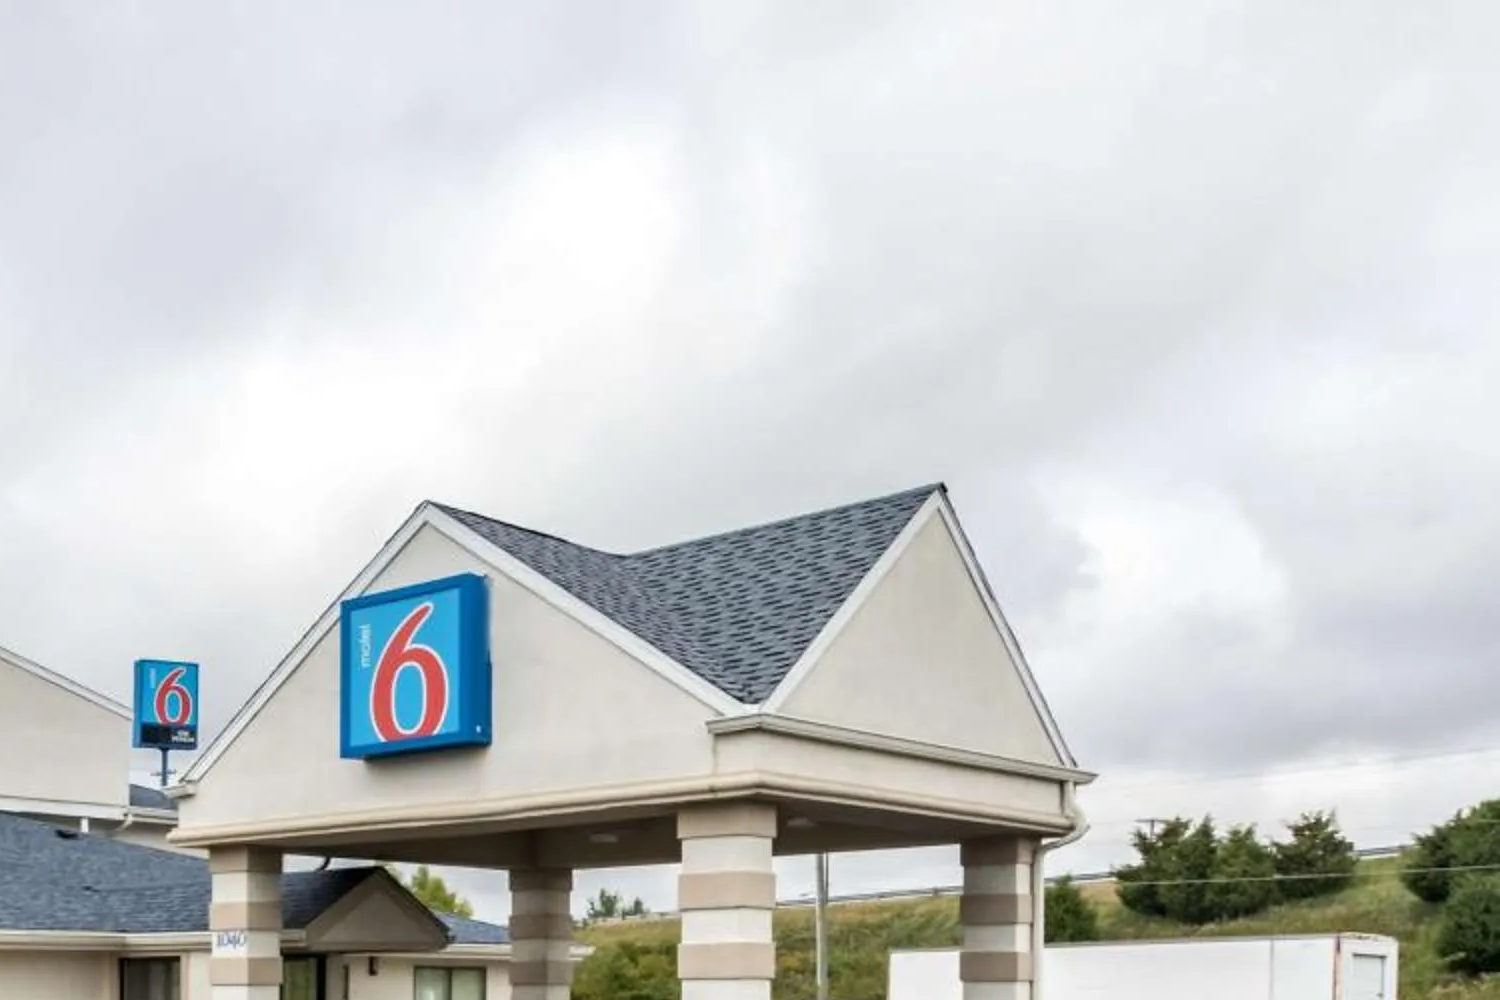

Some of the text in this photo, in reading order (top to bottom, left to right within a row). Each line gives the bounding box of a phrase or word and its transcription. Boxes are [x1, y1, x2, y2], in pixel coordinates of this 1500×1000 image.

[153, 666, 193, 725] 6
[359, 601, 449, 742] motel 6
